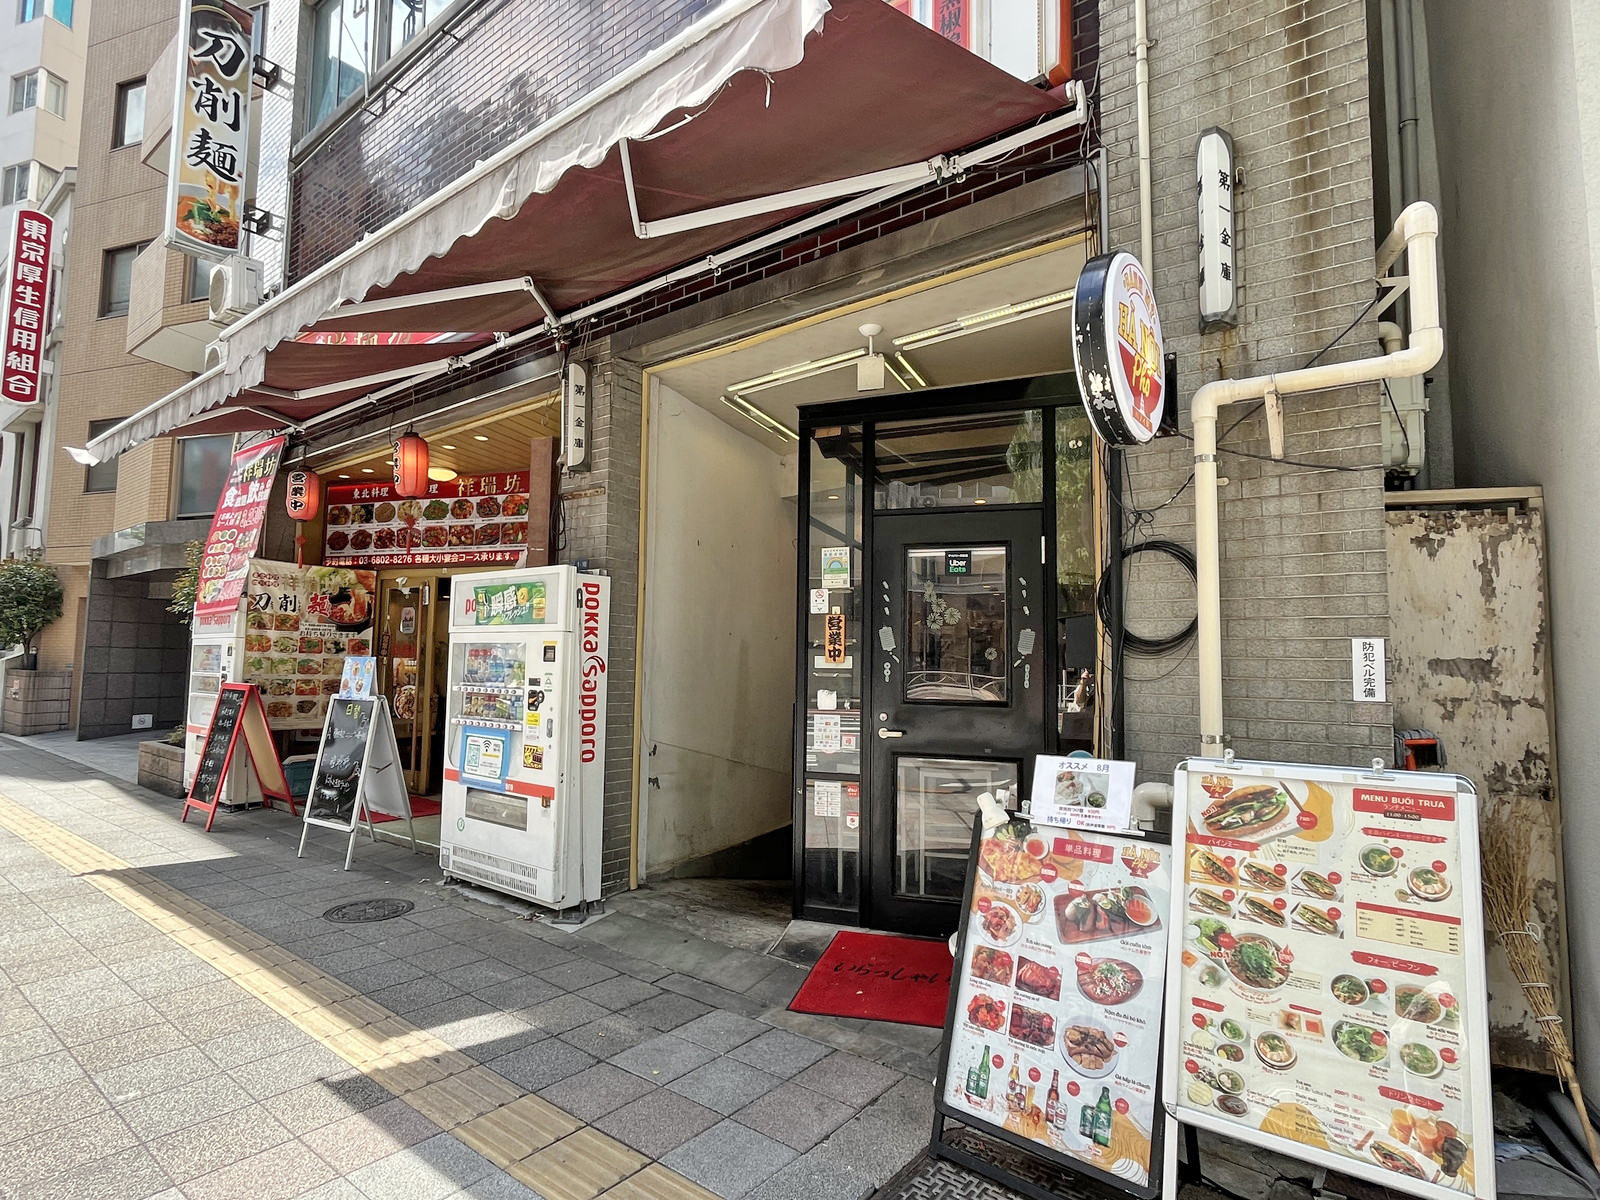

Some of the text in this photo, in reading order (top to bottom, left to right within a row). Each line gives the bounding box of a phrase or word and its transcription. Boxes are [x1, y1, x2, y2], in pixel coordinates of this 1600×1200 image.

[1218, 169, 1232, 281] 第一金庫
[6, 217, 48, 396] 東京厚生信用組合
[574, 384, 586, 448] 第一金庫
[352, 487, 389, 499] 東北料理
[827, 615, 843, 662] 営業中
[1362, 641, 1376, 698] 防犯ベル完備
[1058, 761, 1110, 773] オススメ 8月
[1361, 794, 1389, 803] MENU
[1047, 816, 1072, 825] 持ち帰り
[1064, 843, 1102, 858] 単品料理
